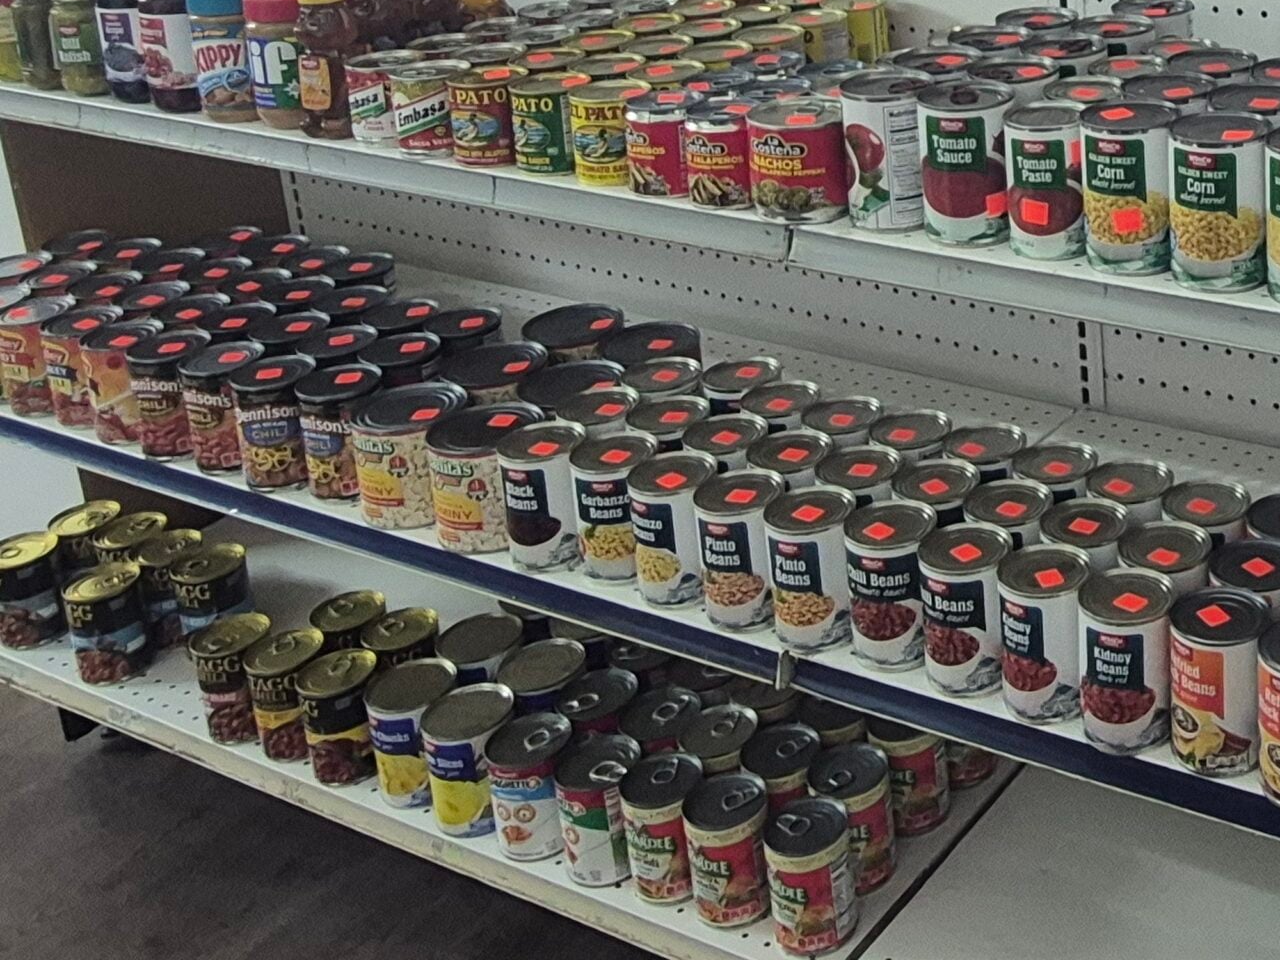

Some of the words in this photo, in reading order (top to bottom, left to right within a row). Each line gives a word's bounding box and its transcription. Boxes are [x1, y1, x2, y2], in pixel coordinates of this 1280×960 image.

[931, 135, 977, 150] Tomato
[936, 149, 973, 164] Sauce
[1016, 156, 1057, 170] Tomato
[1021, 170, 1053, 183] Paste
[1097, 164, 1125, 180] Corn
[1186, 178, 1216, 195] Corn
[589, 506, 624, 519] Beans
[705, 536, 736, 552] Pinto
[705, 549, 741, 567] Beans
[775, 555, 807, 572] Pinto
[775, 569, 811, 587] Beans
[869, 573, 911, 588] Beans
[935, 595, 975, 613] Beans
[1093, 646, 1132, 665] Kidney
[1095, 659, 1129, 676] Beans
[1181, 672, 1217, 697] Beans
